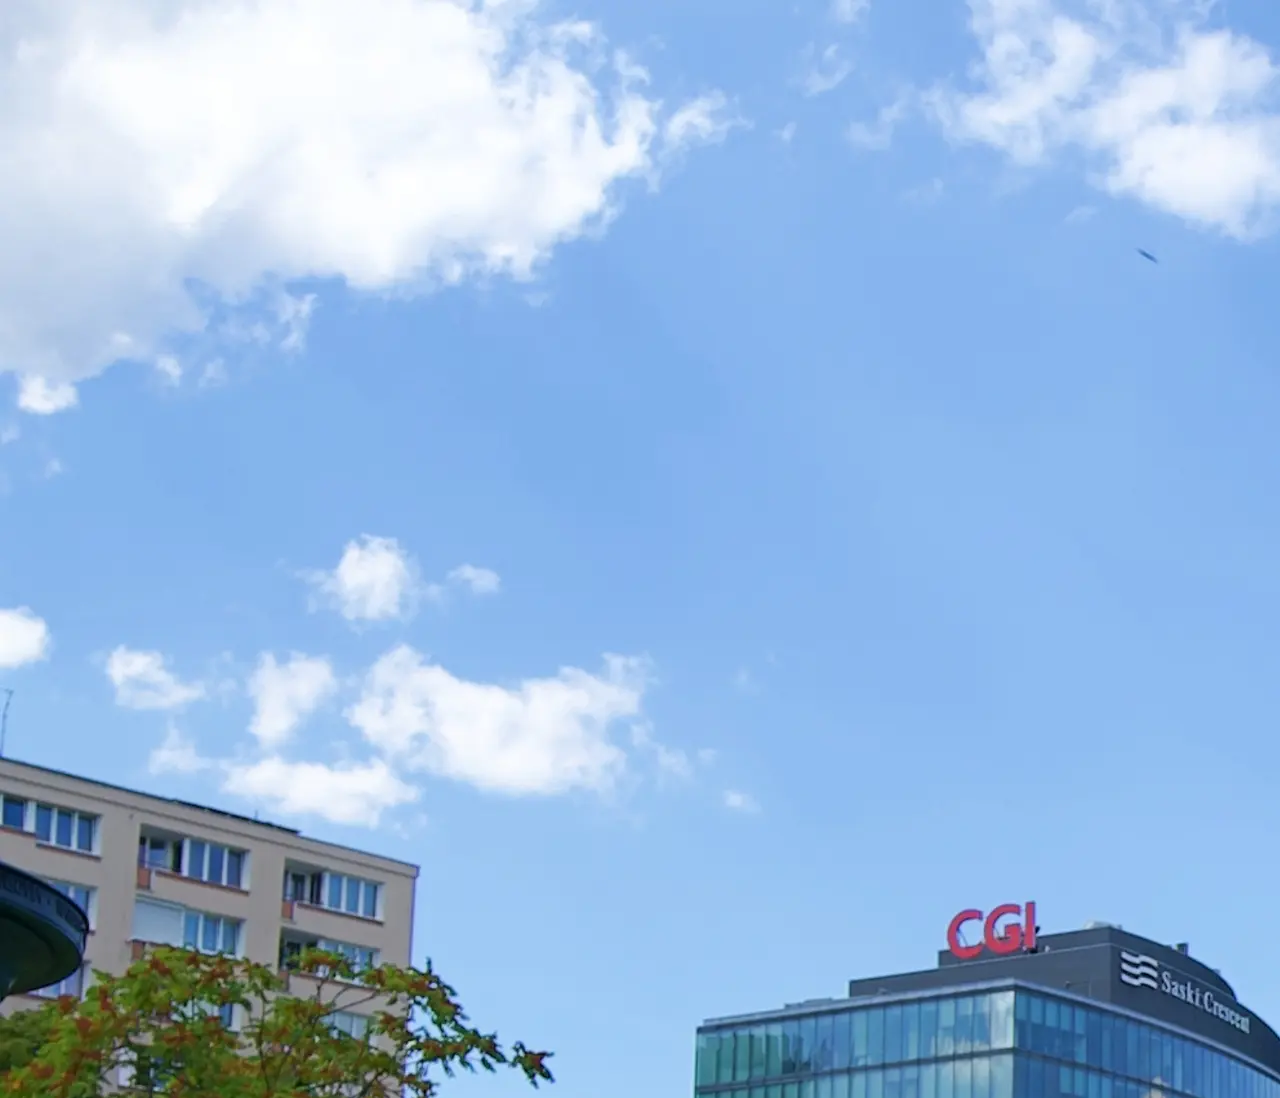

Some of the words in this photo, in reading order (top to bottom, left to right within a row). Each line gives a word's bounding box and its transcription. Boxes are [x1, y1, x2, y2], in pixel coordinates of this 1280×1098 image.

[947, 900, 1036, 959] CGI
[1161, 971, 1201, 1008] Saski
[1203, 991, 1251, 1035] Crescent
